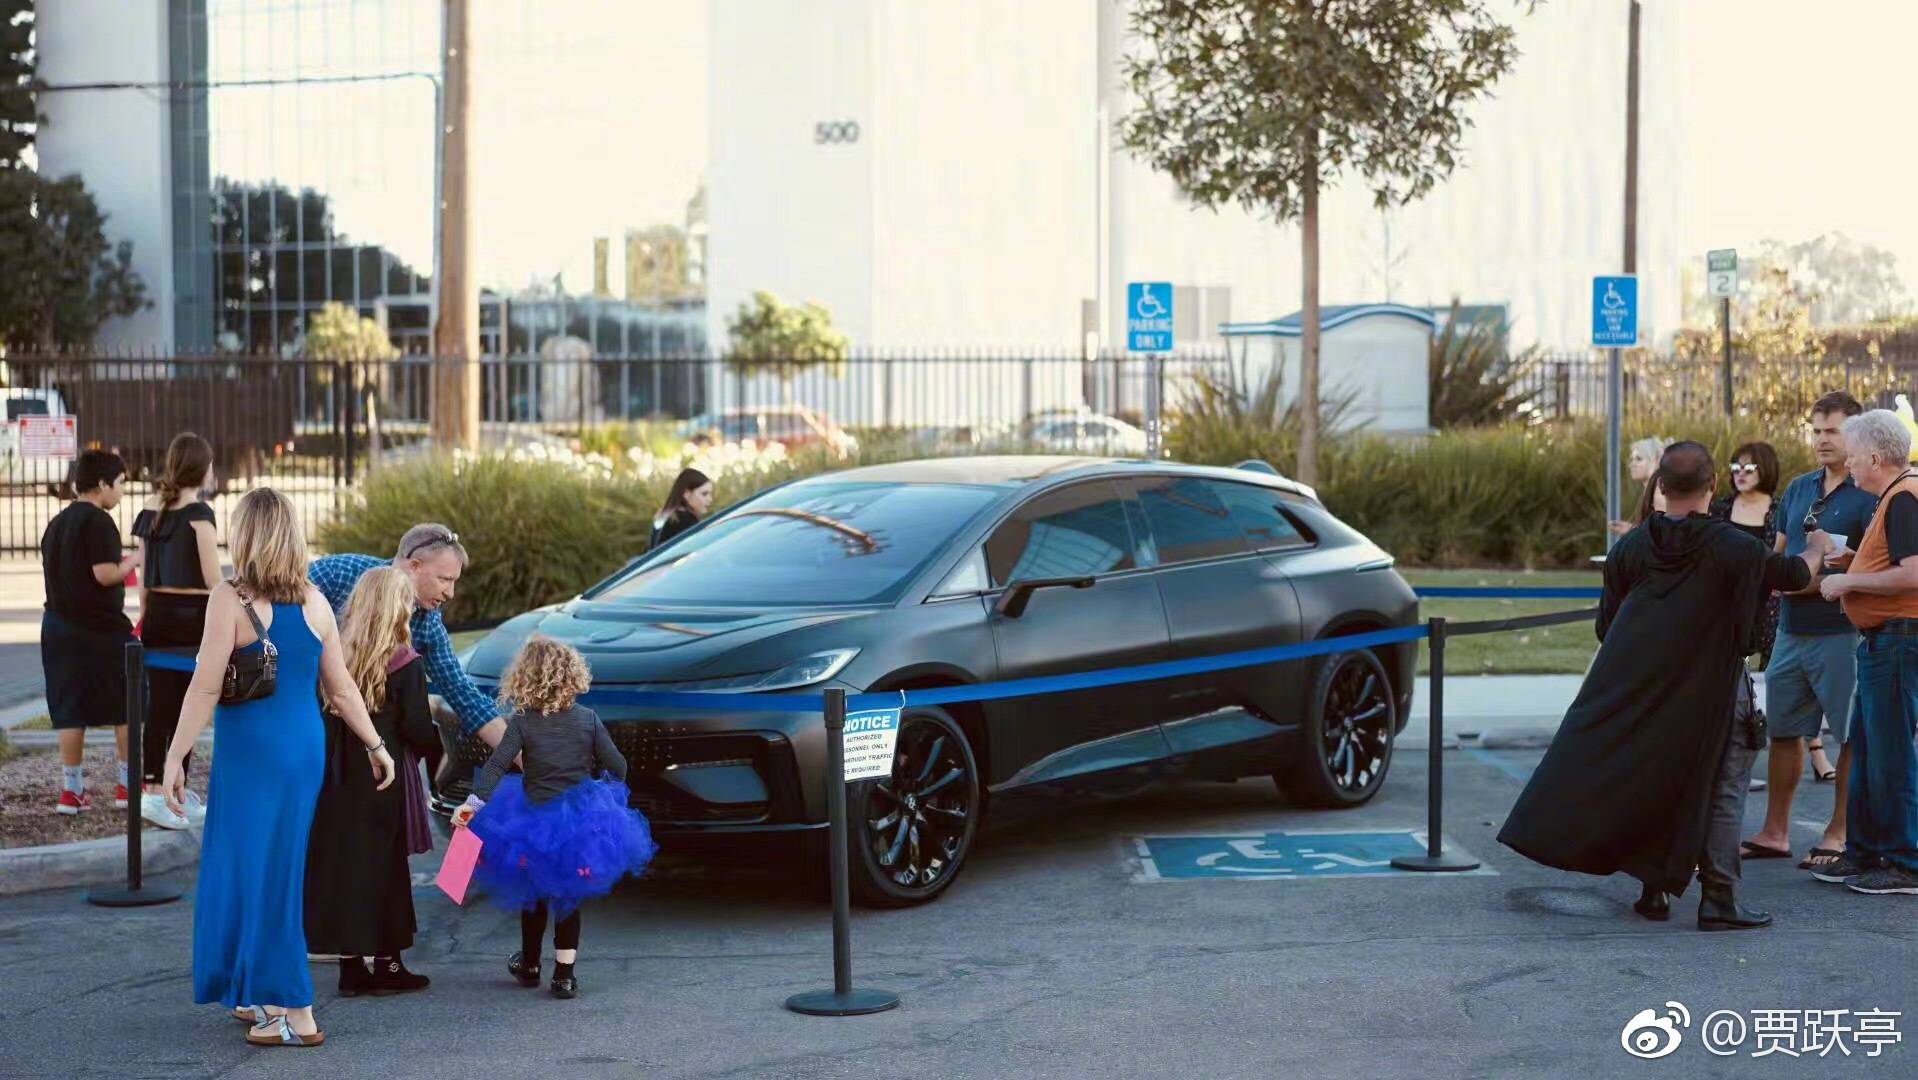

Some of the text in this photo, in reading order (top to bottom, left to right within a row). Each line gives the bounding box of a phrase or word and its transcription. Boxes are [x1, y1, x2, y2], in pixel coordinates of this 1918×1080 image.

[816, 121, 860, 144] 500
[1717, 275, 1729, 292] 2
[843, 716, 891, 732] NOTICE
[847, 734, 882, 743] AUTHORIZED
[851, 765, 881, 774] REQUIRED
